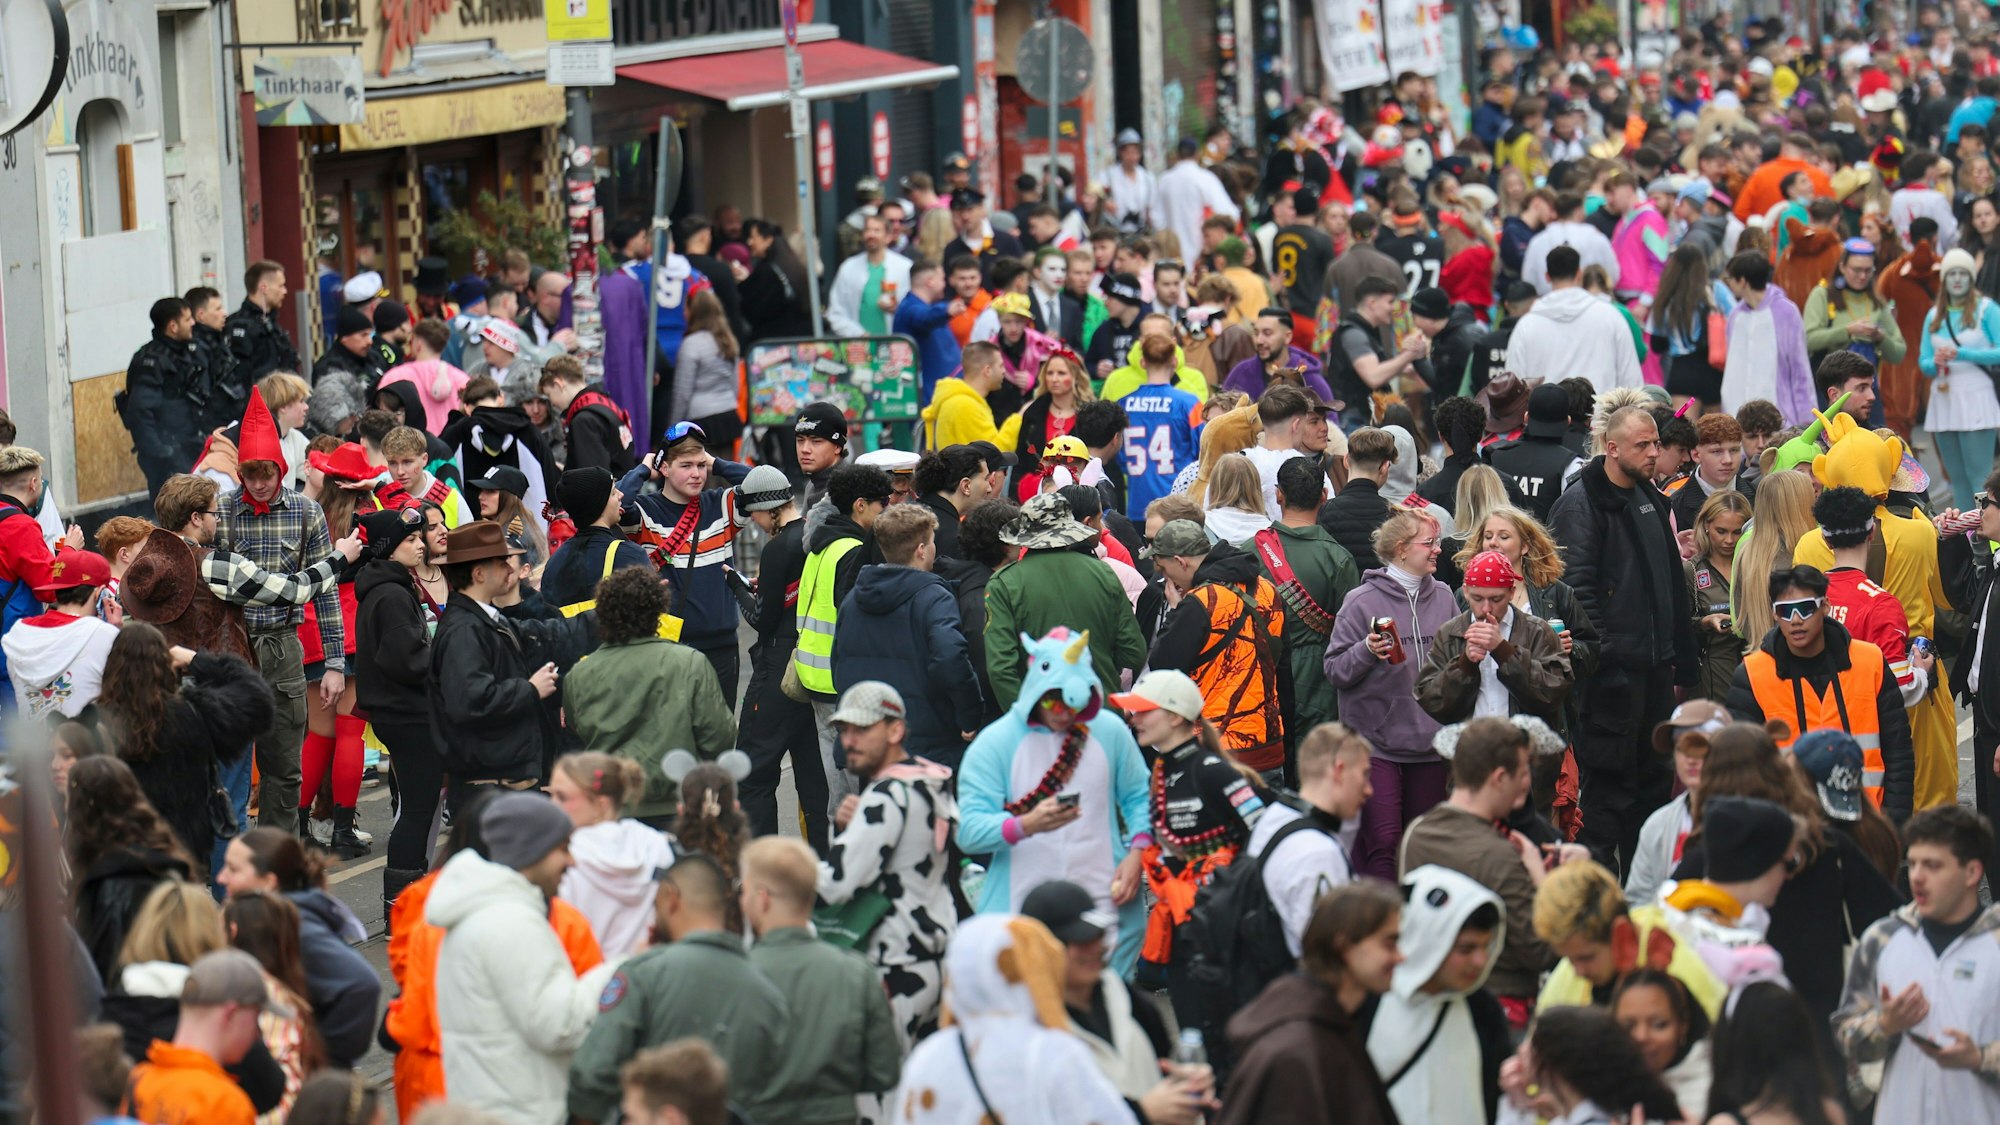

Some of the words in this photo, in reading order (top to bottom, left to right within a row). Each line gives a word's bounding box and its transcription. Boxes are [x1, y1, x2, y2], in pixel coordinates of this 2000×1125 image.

[264, 78, 342, 95] tinkhaar
[3, 133, 17, 170] 30
[1278, 245, 1298, 287] 8
[1402, 259, 1441, 303] 27
[1125, 396, 1173, 413] CASTLE
[1123, 424, 1175, 476] 54
